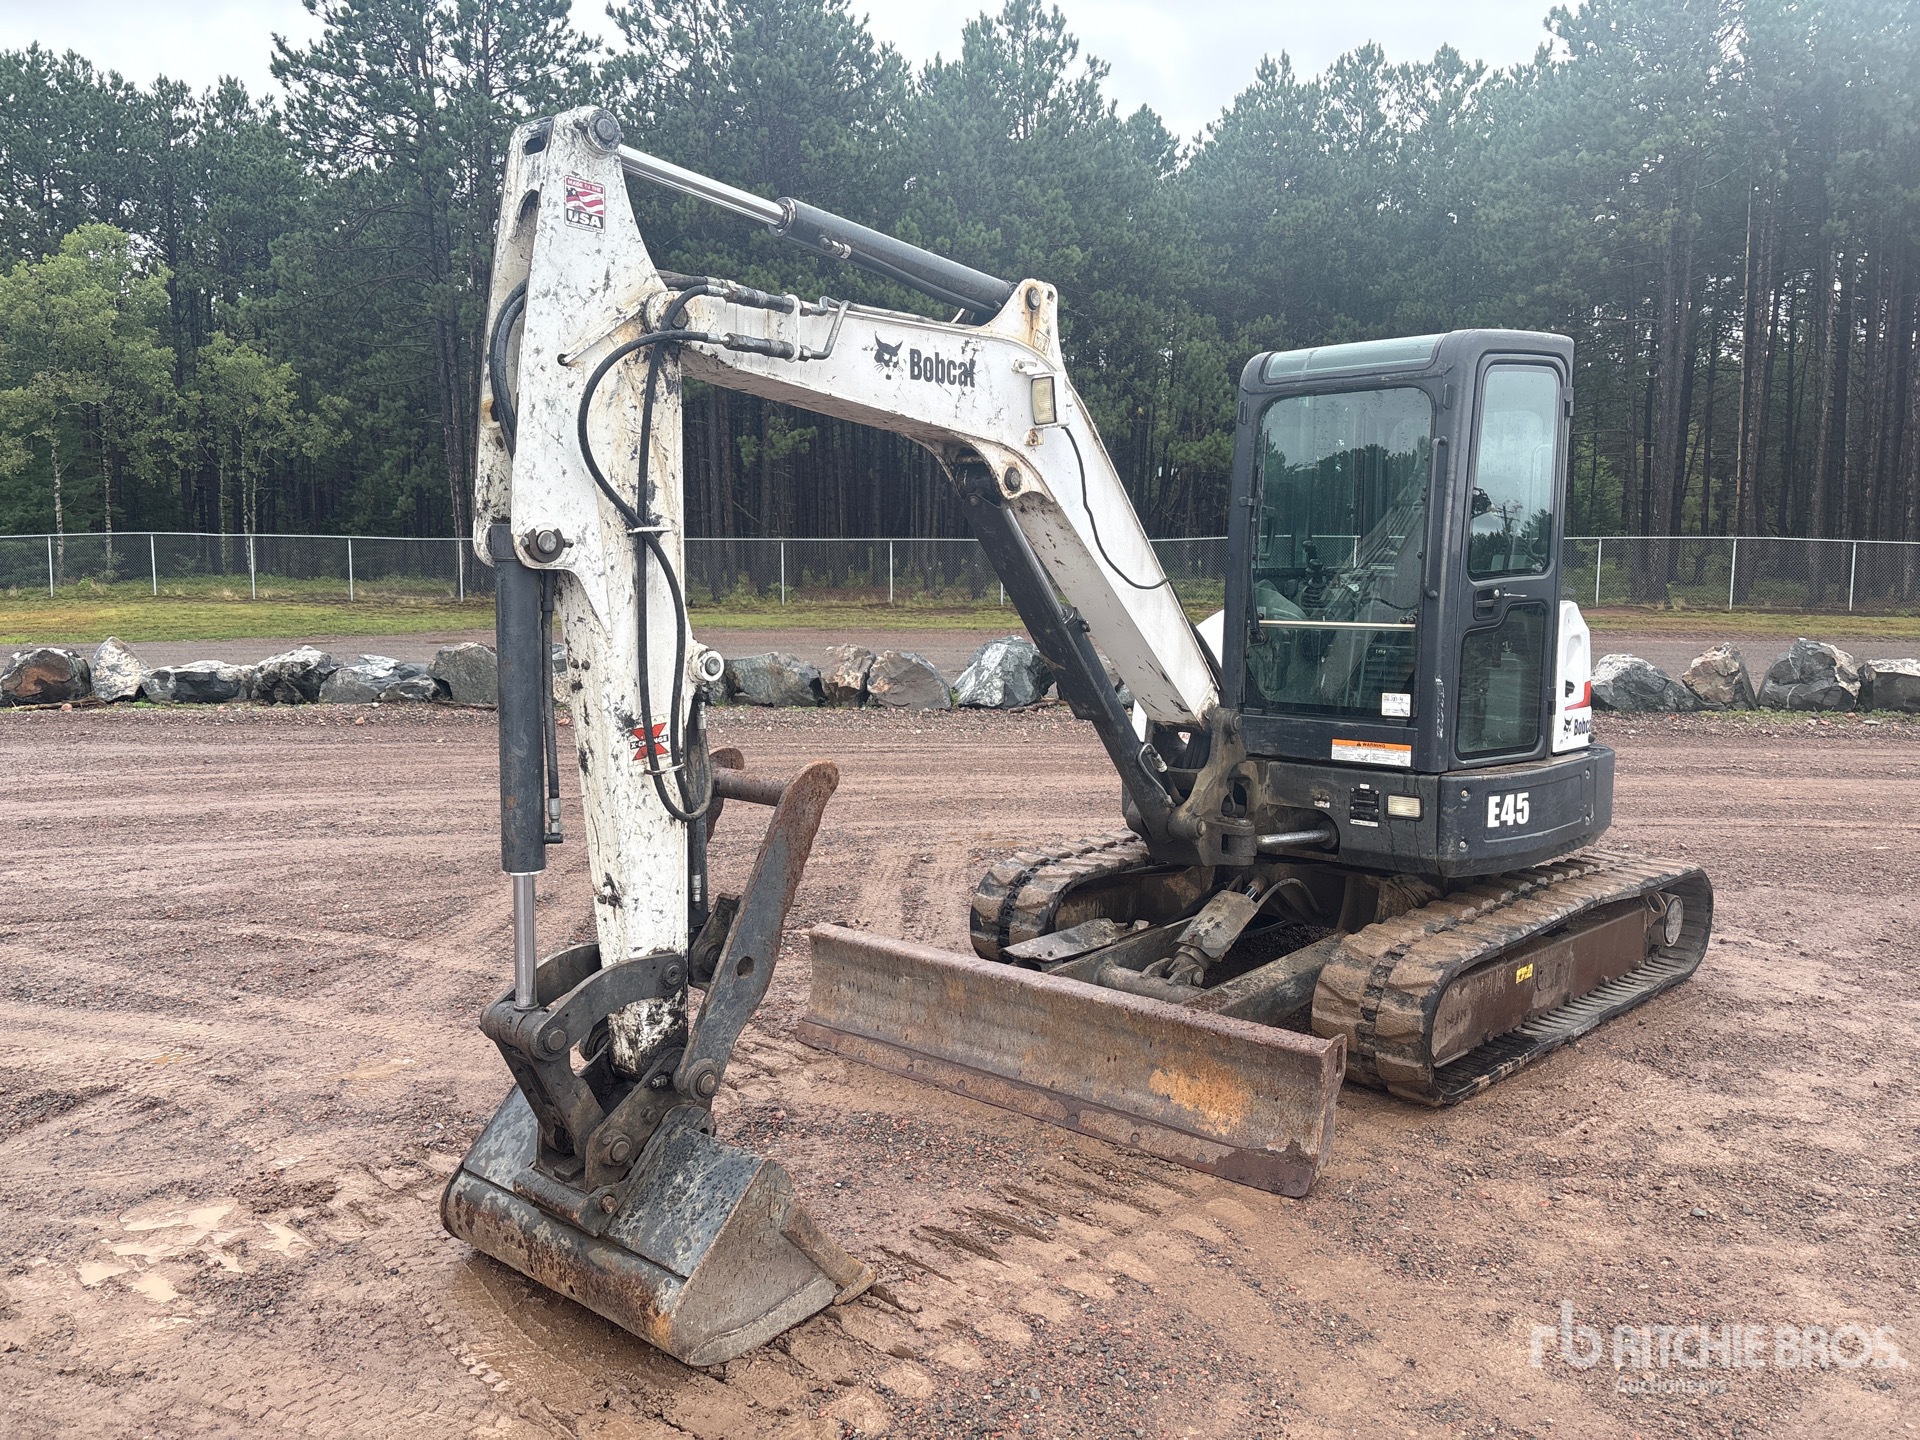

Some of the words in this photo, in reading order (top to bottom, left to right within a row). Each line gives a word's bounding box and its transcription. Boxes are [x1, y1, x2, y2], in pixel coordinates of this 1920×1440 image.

[567, 178, 584, 189] MADE
[591, 185, 602, 193] THE
[567, 209, 602, 229] USA
[909, 347, 977, 388] Bobcat
[630, 735, 669, 749] X-CHNGE
[1487, 792, 1530, 828] E45
